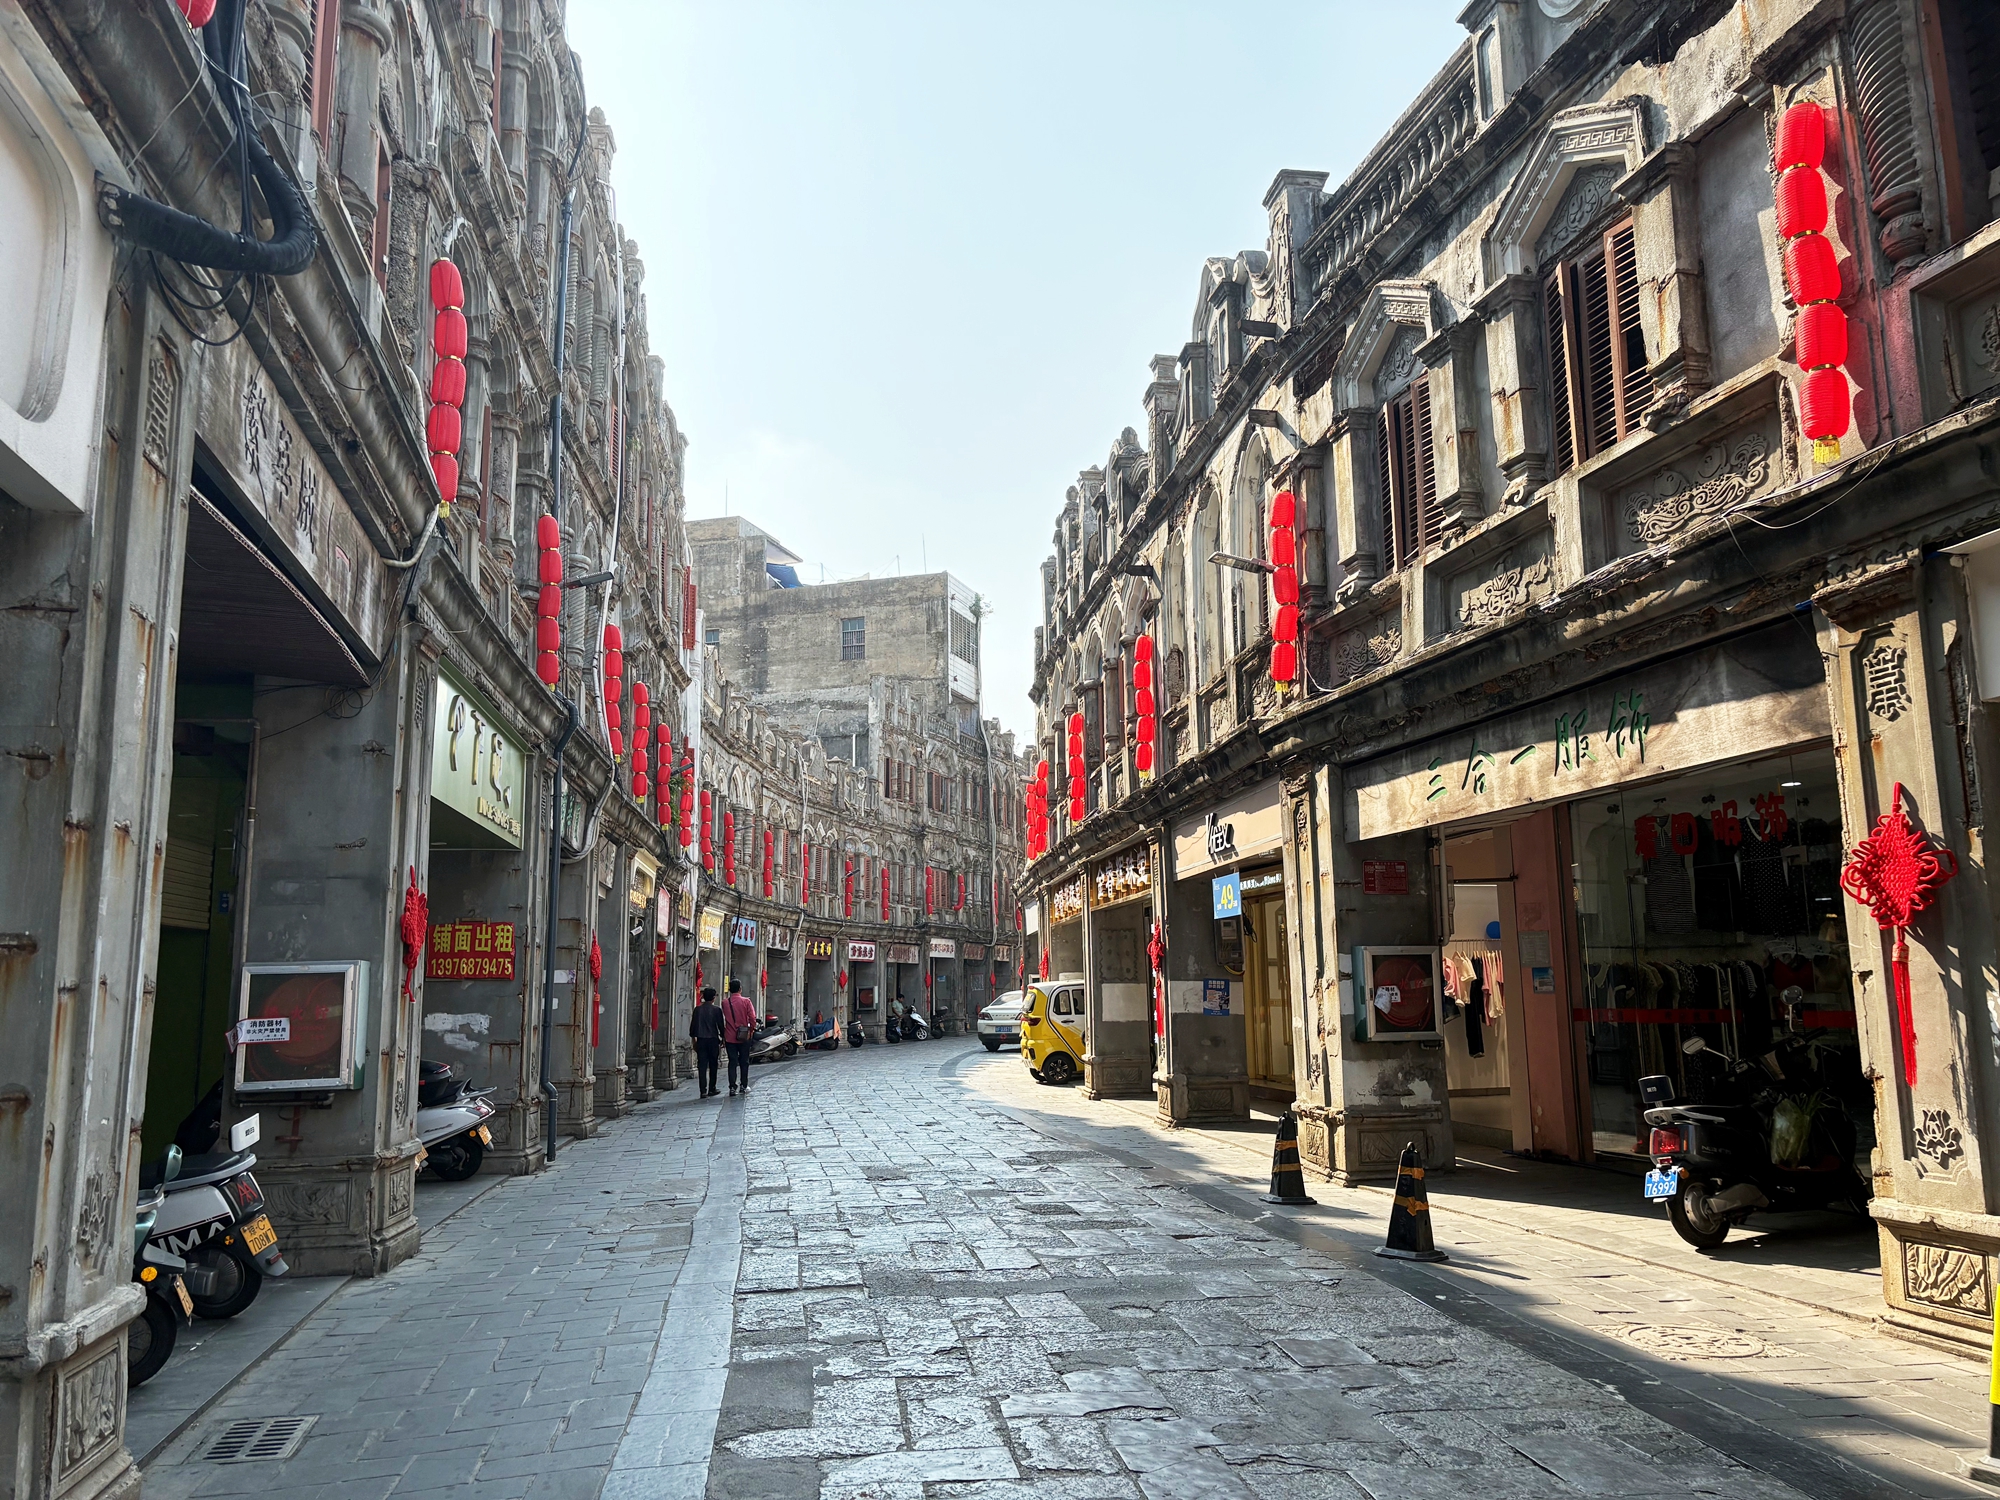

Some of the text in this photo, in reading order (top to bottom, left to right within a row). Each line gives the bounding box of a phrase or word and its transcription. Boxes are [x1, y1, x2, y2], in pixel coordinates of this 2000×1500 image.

[1221, 884, 1235, 910] 49
[432, 923, 513, 952] 铺面出租
[431, 958, 512, 975] 13976879475
[249, 1019, 282, 1028] 消防器材
[1646, 1181, 1675, 1196] 76992
